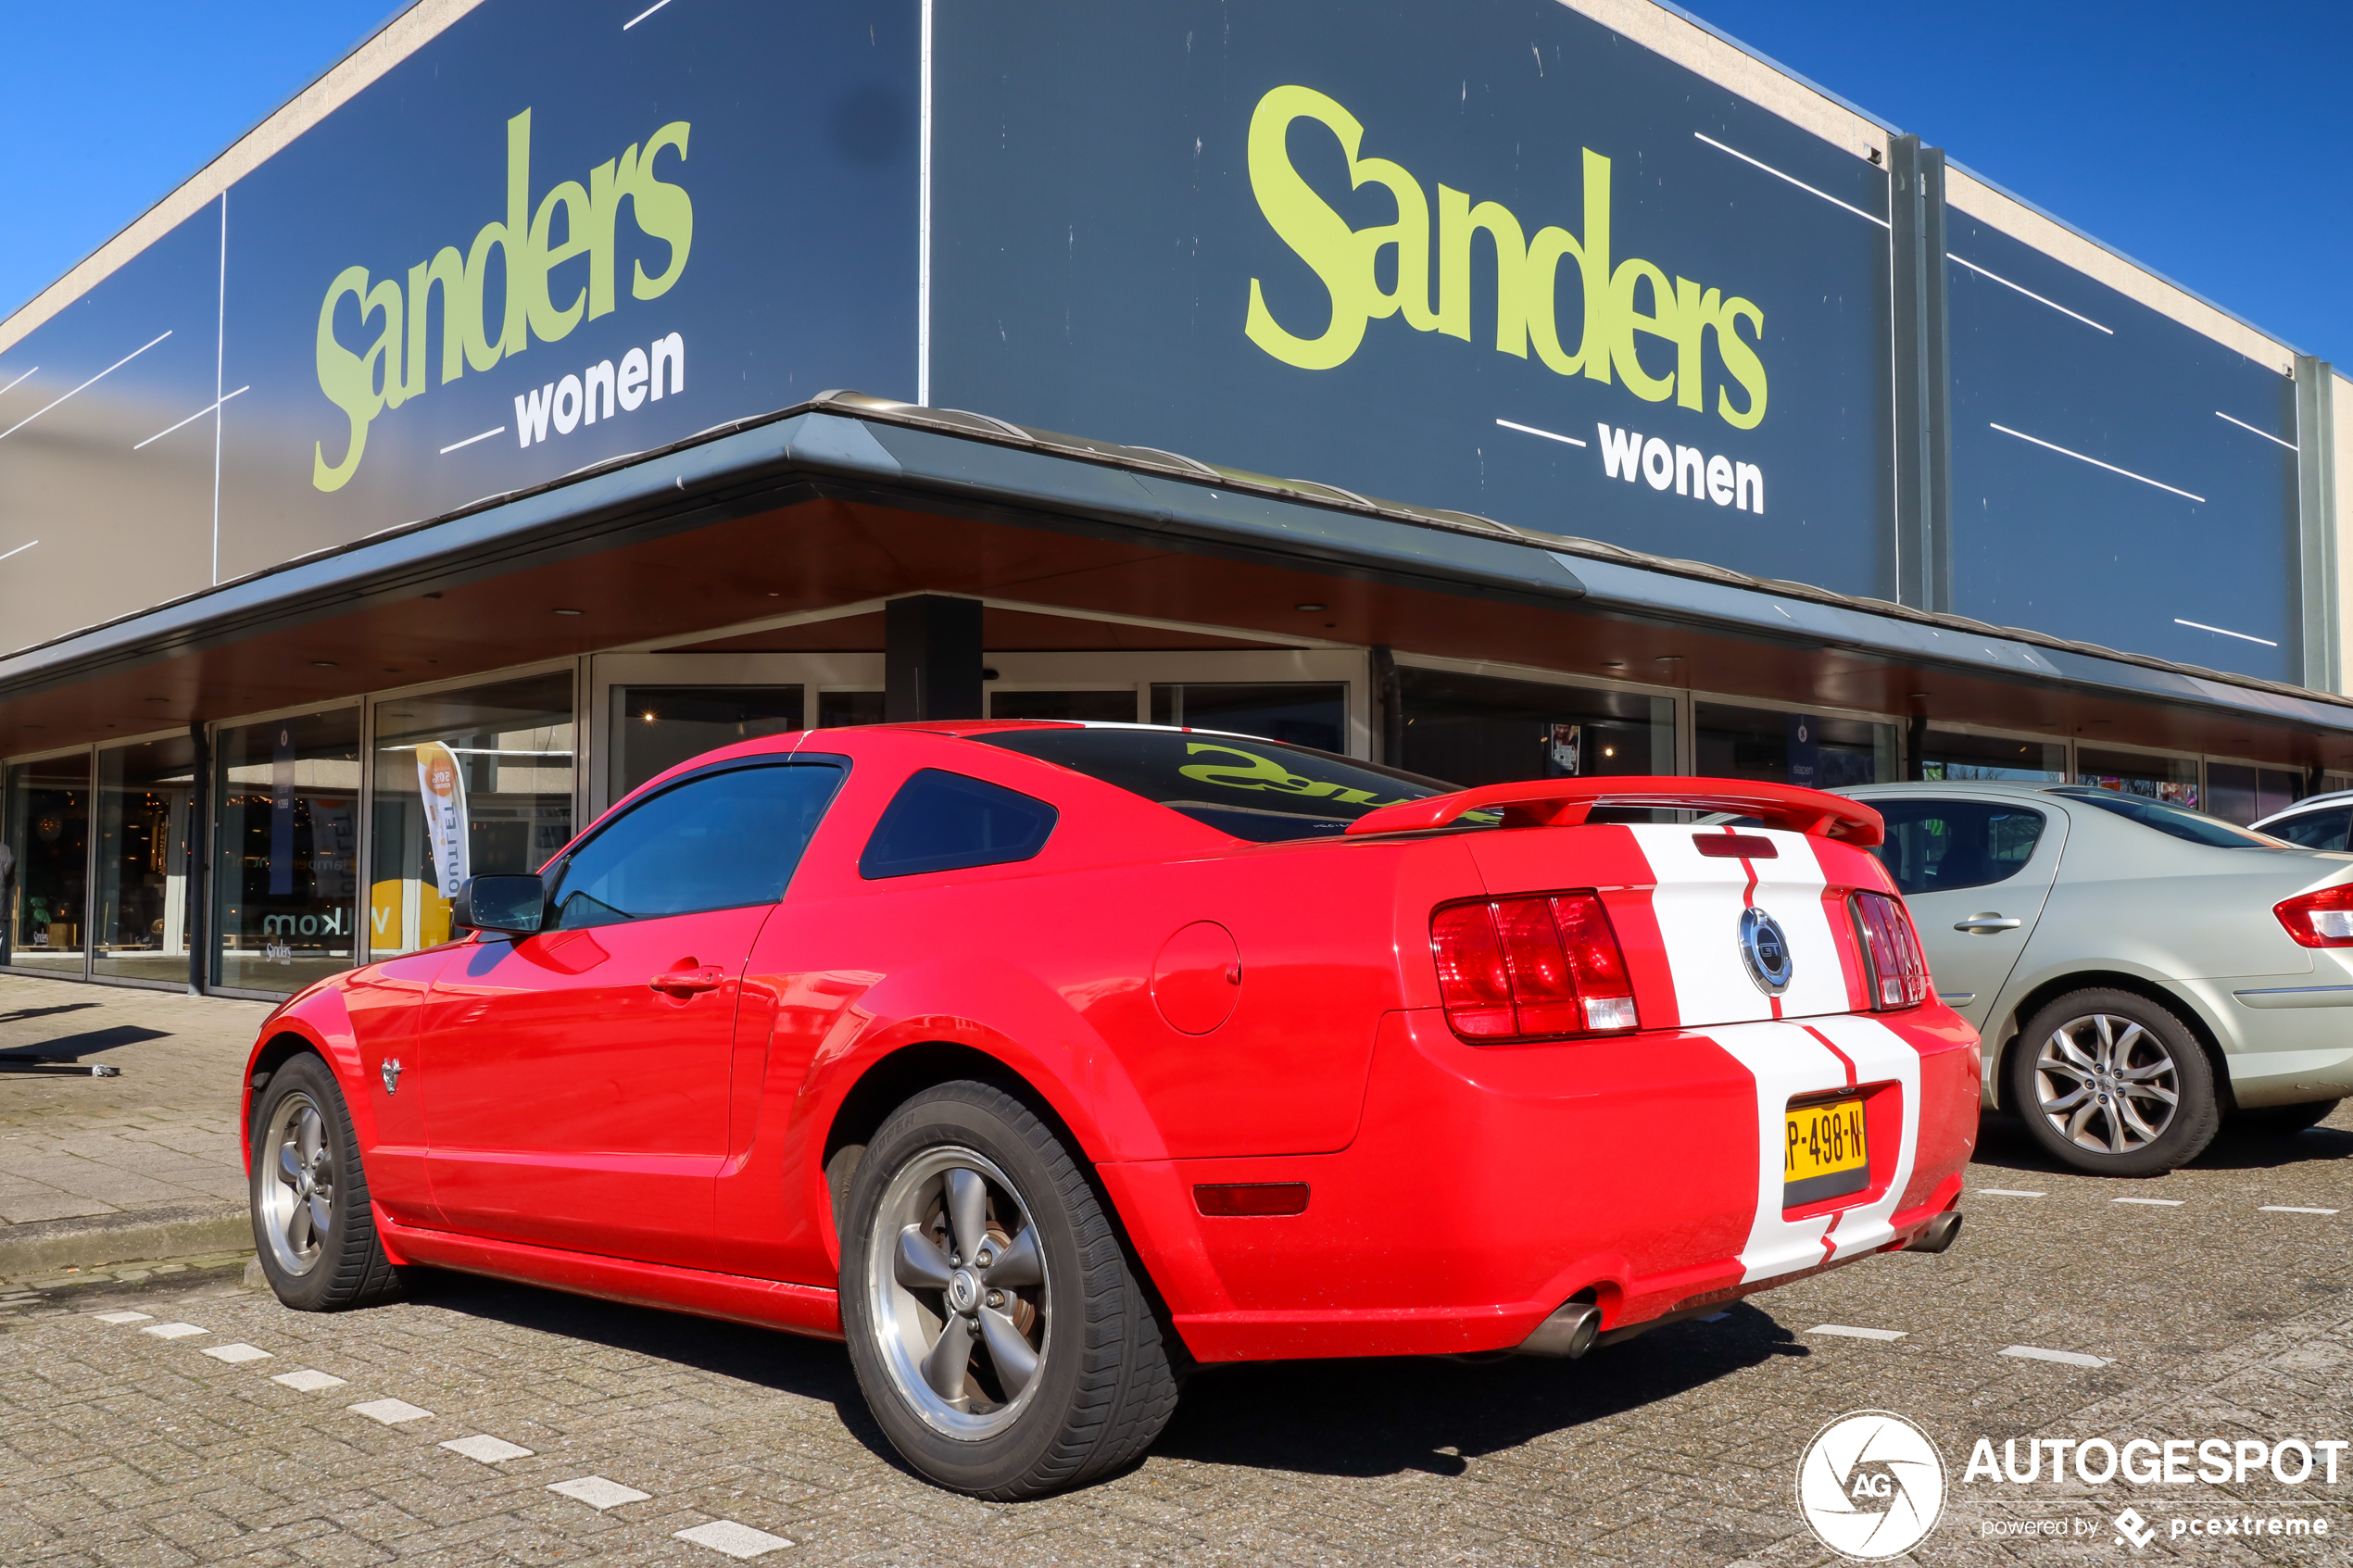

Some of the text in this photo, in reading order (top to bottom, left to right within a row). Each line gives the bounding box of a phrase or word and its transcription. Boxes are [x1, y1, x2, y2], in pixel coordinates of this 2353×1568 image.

[313, 107, 693, 492] Sanders
[1244, 84, 1768, 430] Sanders
[514, 332, 685, 448] wonen
[1597, 422, 1764, 514] wonen
[266, 938, 292, 962] Sanders
[1784, 1110, 1861, 1172] P-498-N
